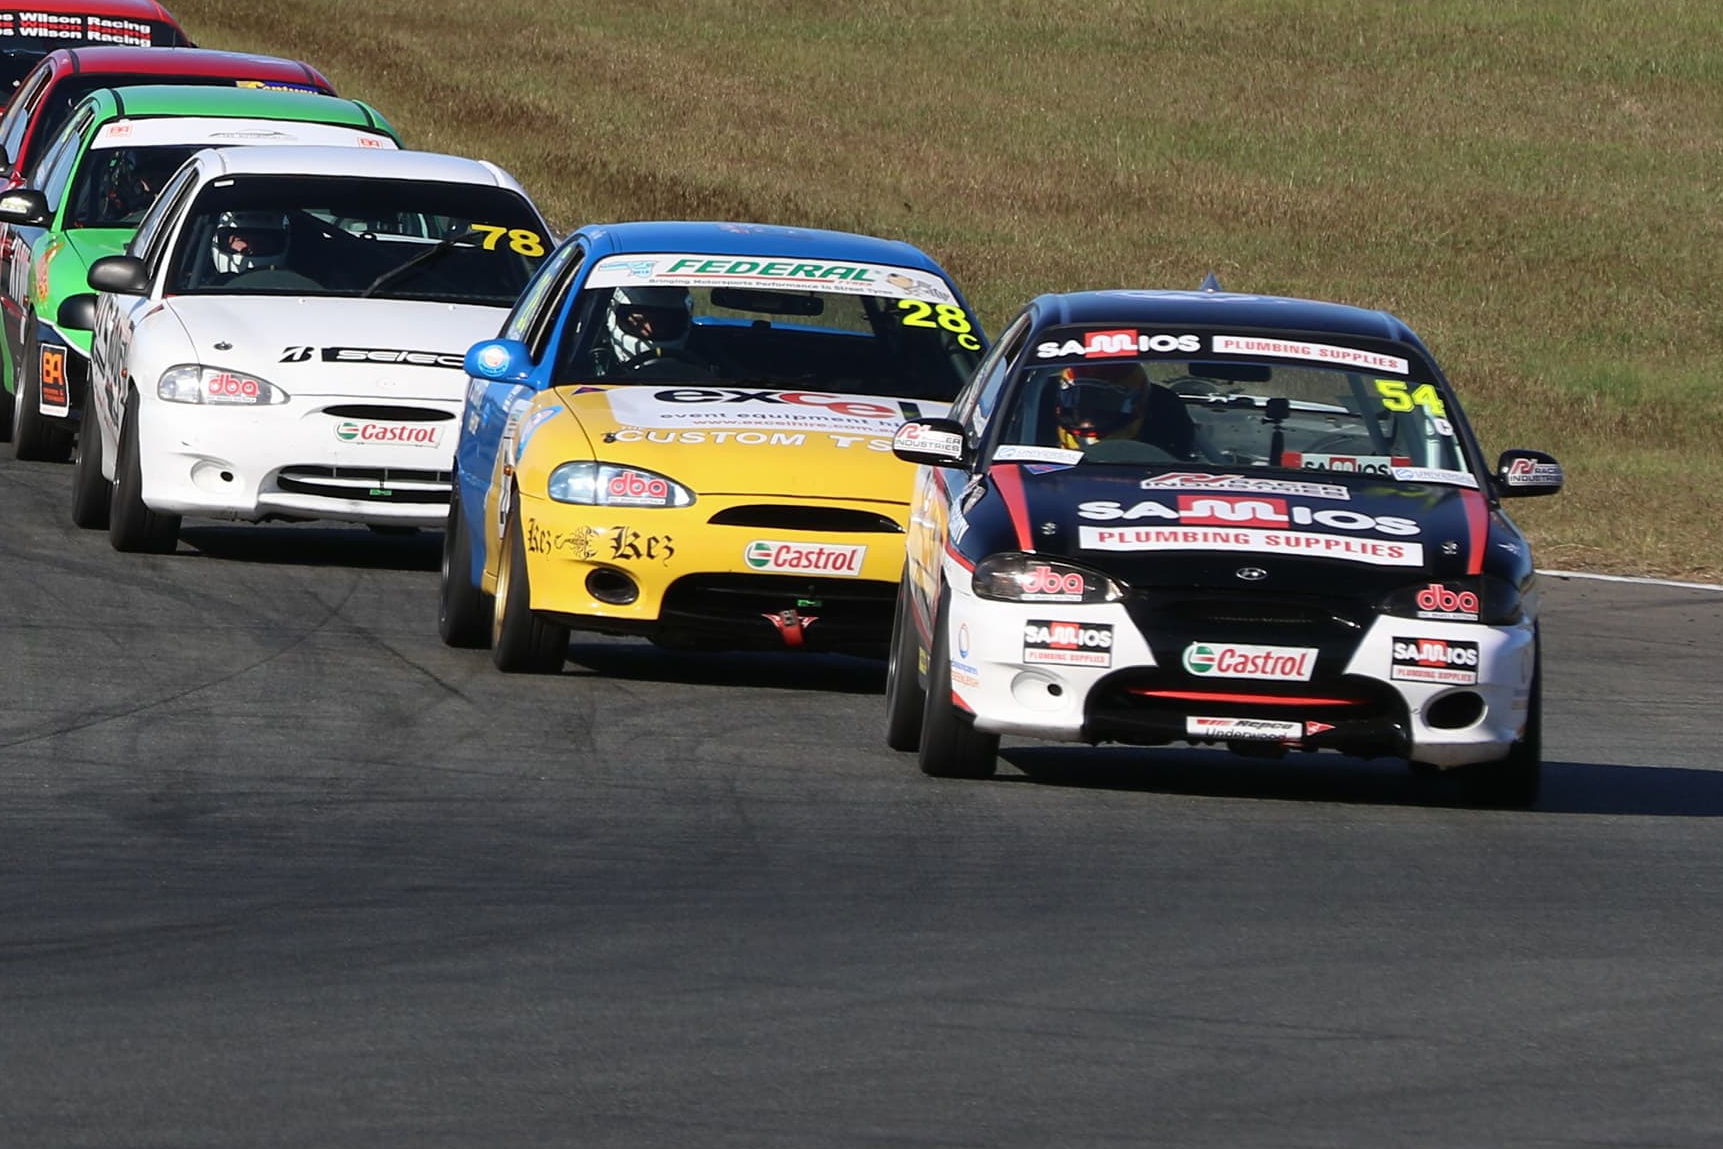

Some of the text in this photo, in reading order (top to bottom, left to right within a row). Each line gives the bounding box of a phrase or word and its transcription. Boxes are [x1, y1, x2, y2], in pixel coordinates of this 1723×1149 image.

[19, 12, 82, 25] Wilson
[87, 16, 151, 34] Racing
[19, 26, 82, 39] Wilson
[87, 31, 151, 48] Racing
[471, 223, 545, 257] 78
[667, 258, 876, 282] FEDERAL
[649, 278, 691, 286] Bringing
[693, 279, 754, 287] Motorsports
[755, 280, 819, 289] Performance
[833, 285, 864, 293] Street
[897, 299, 972, 334] 28
[1037, 329, 1400, 369] SAMIOS PLUMBING SUPPLIES
[207, 372, 259, 397] dba
[653, 388, 923, 420] excel
[1374, 379, 1447, 418] 54
[361, 423, 436, 442] Castrol
[737, 412, 870, 425] equipment
[882, 419, 899, 427] hi
[614, 430, 807, 447] CUSTOM
[895, 437, 961, 453] INDUSTRIES
[609, 472, 668, 498] dba
[1077, 494, 1422, 536] SAMIOS
[610, 525, 675, 567] Kez
[774, 543, 859, 572] Castrol
[1098, 530, 1405, 559] PLUMBING SUPPLIES
[1023, 565, 1085, 594] dba
[1416, 583, 1479, 614] dba
[1024, 623, 1113, 649] SAMIOS
[1029, 651, 1105, 664] PLUMBING SUPPLIES
[1216, 648, 1309, 677] Castrol
[1394, 639, 1478, 666] SAMIOS
[1397, 668, 1473, 683] PLUMBING SUPPLIES
[1205, 728, 1288, 739] Underwood
[1236, 719, 1294, 730] Repco
